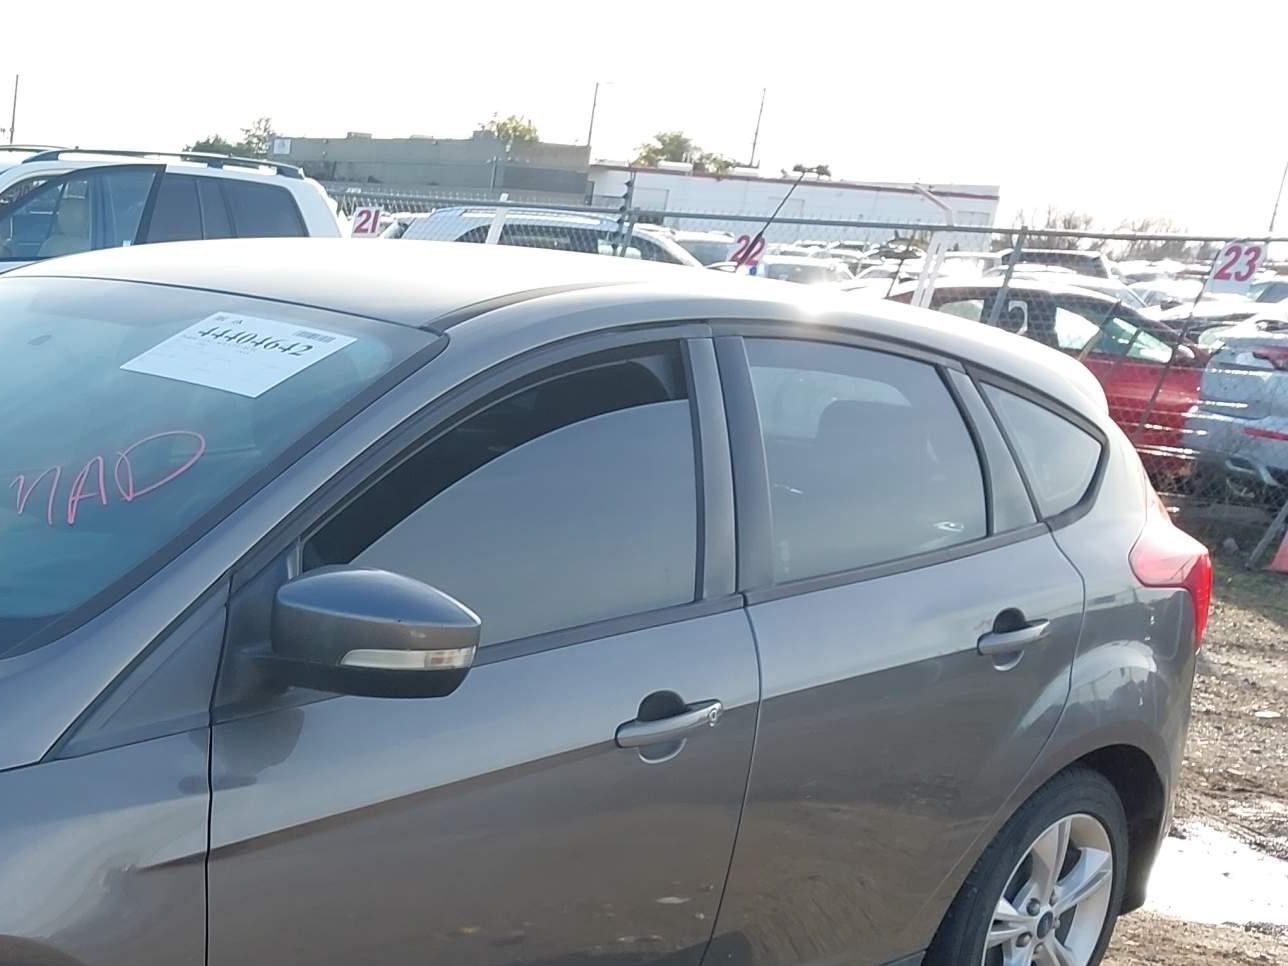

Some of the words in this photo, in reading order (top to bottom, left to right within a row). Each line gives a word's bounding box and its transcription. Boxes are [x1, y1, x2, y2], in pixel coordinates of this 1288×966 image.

[354, 209, 379, 233] 21
[730, 235, 766, 265] 22
[1213, 245, 1262, 282] 23
[198, 326, 313, 356] 44404642
